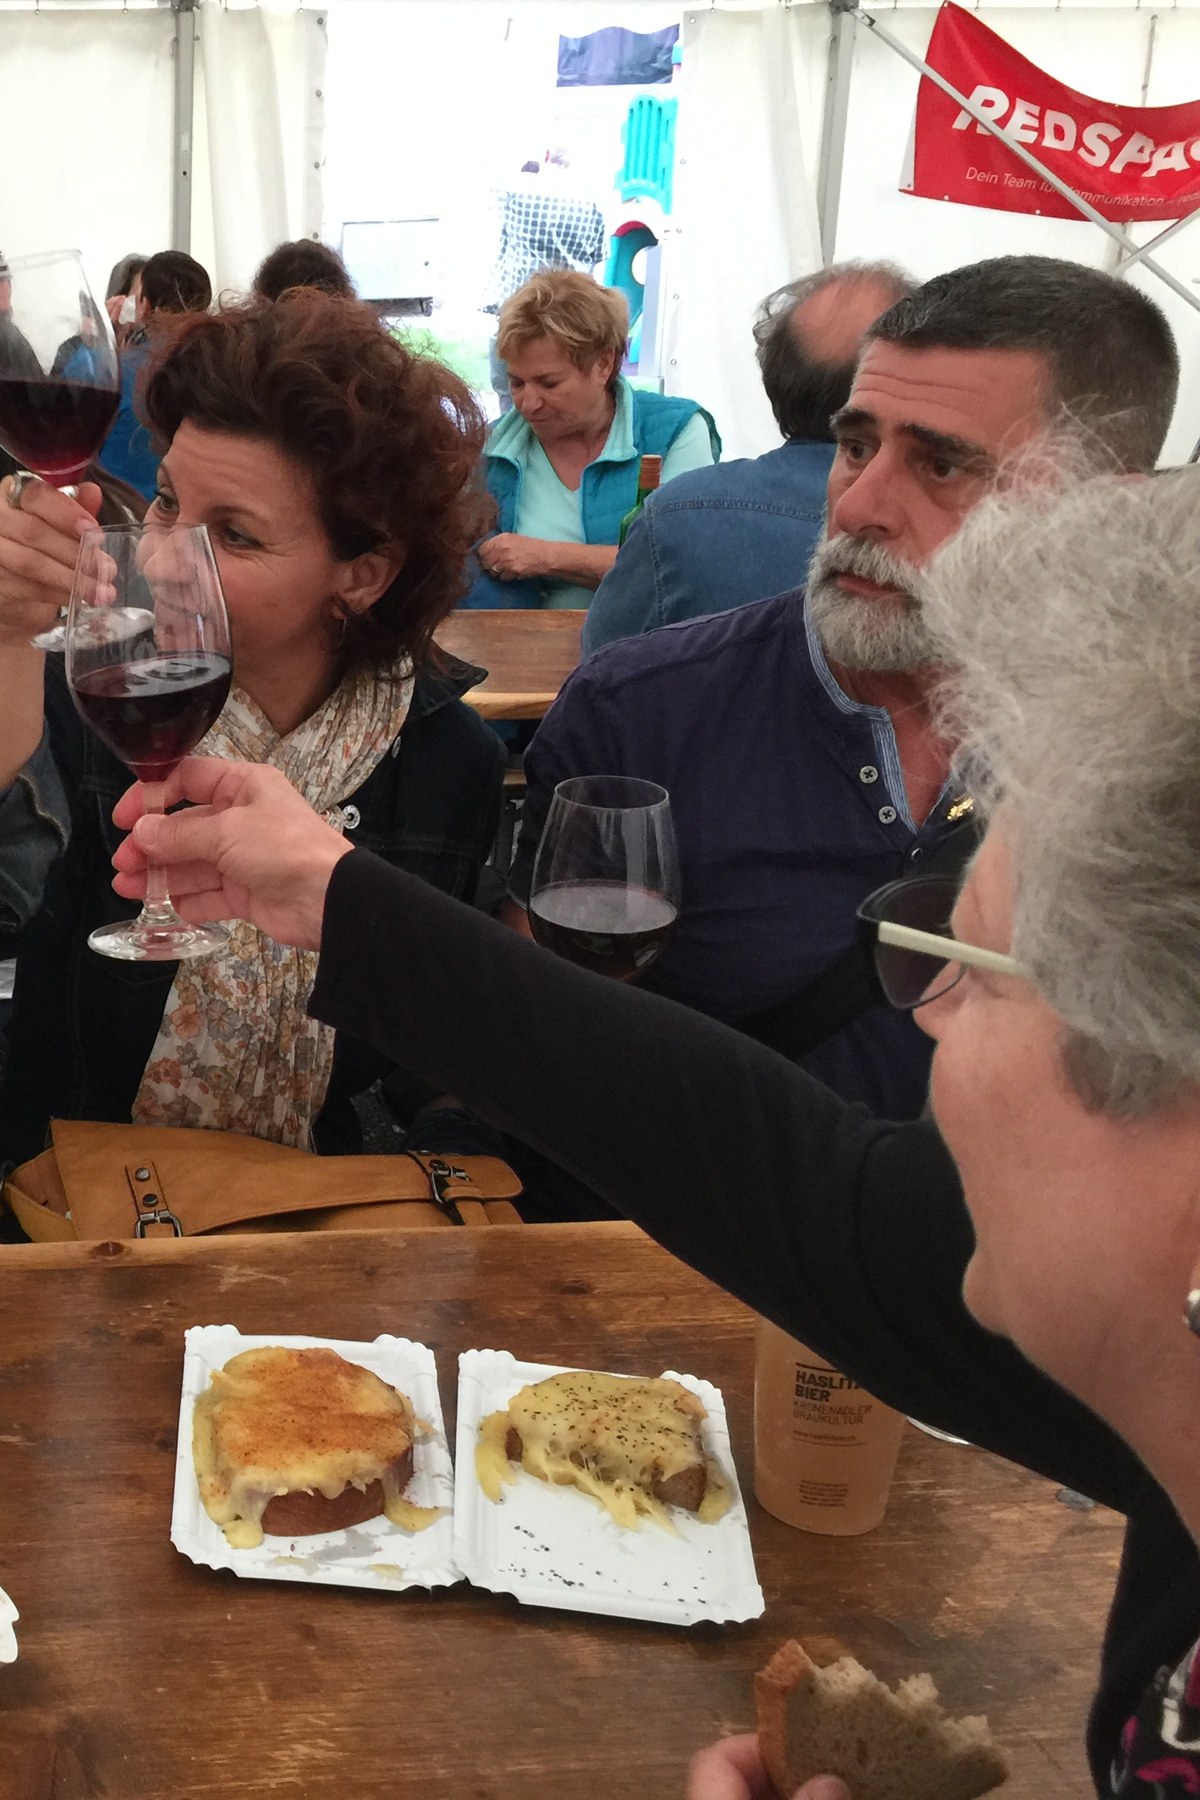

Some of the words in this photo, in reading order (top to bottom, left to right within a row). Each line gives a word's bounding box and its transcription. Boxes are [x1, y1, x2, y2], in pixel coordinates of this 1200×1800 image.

[952, 85, 1200, 177] REDSPA
[965, 167, 998, 184] Dein
[1003, 173, 1036, 190] Team
[1070, 186, 1164, 207] ommunikation
[795, 1385, 831, 1402] BIER
